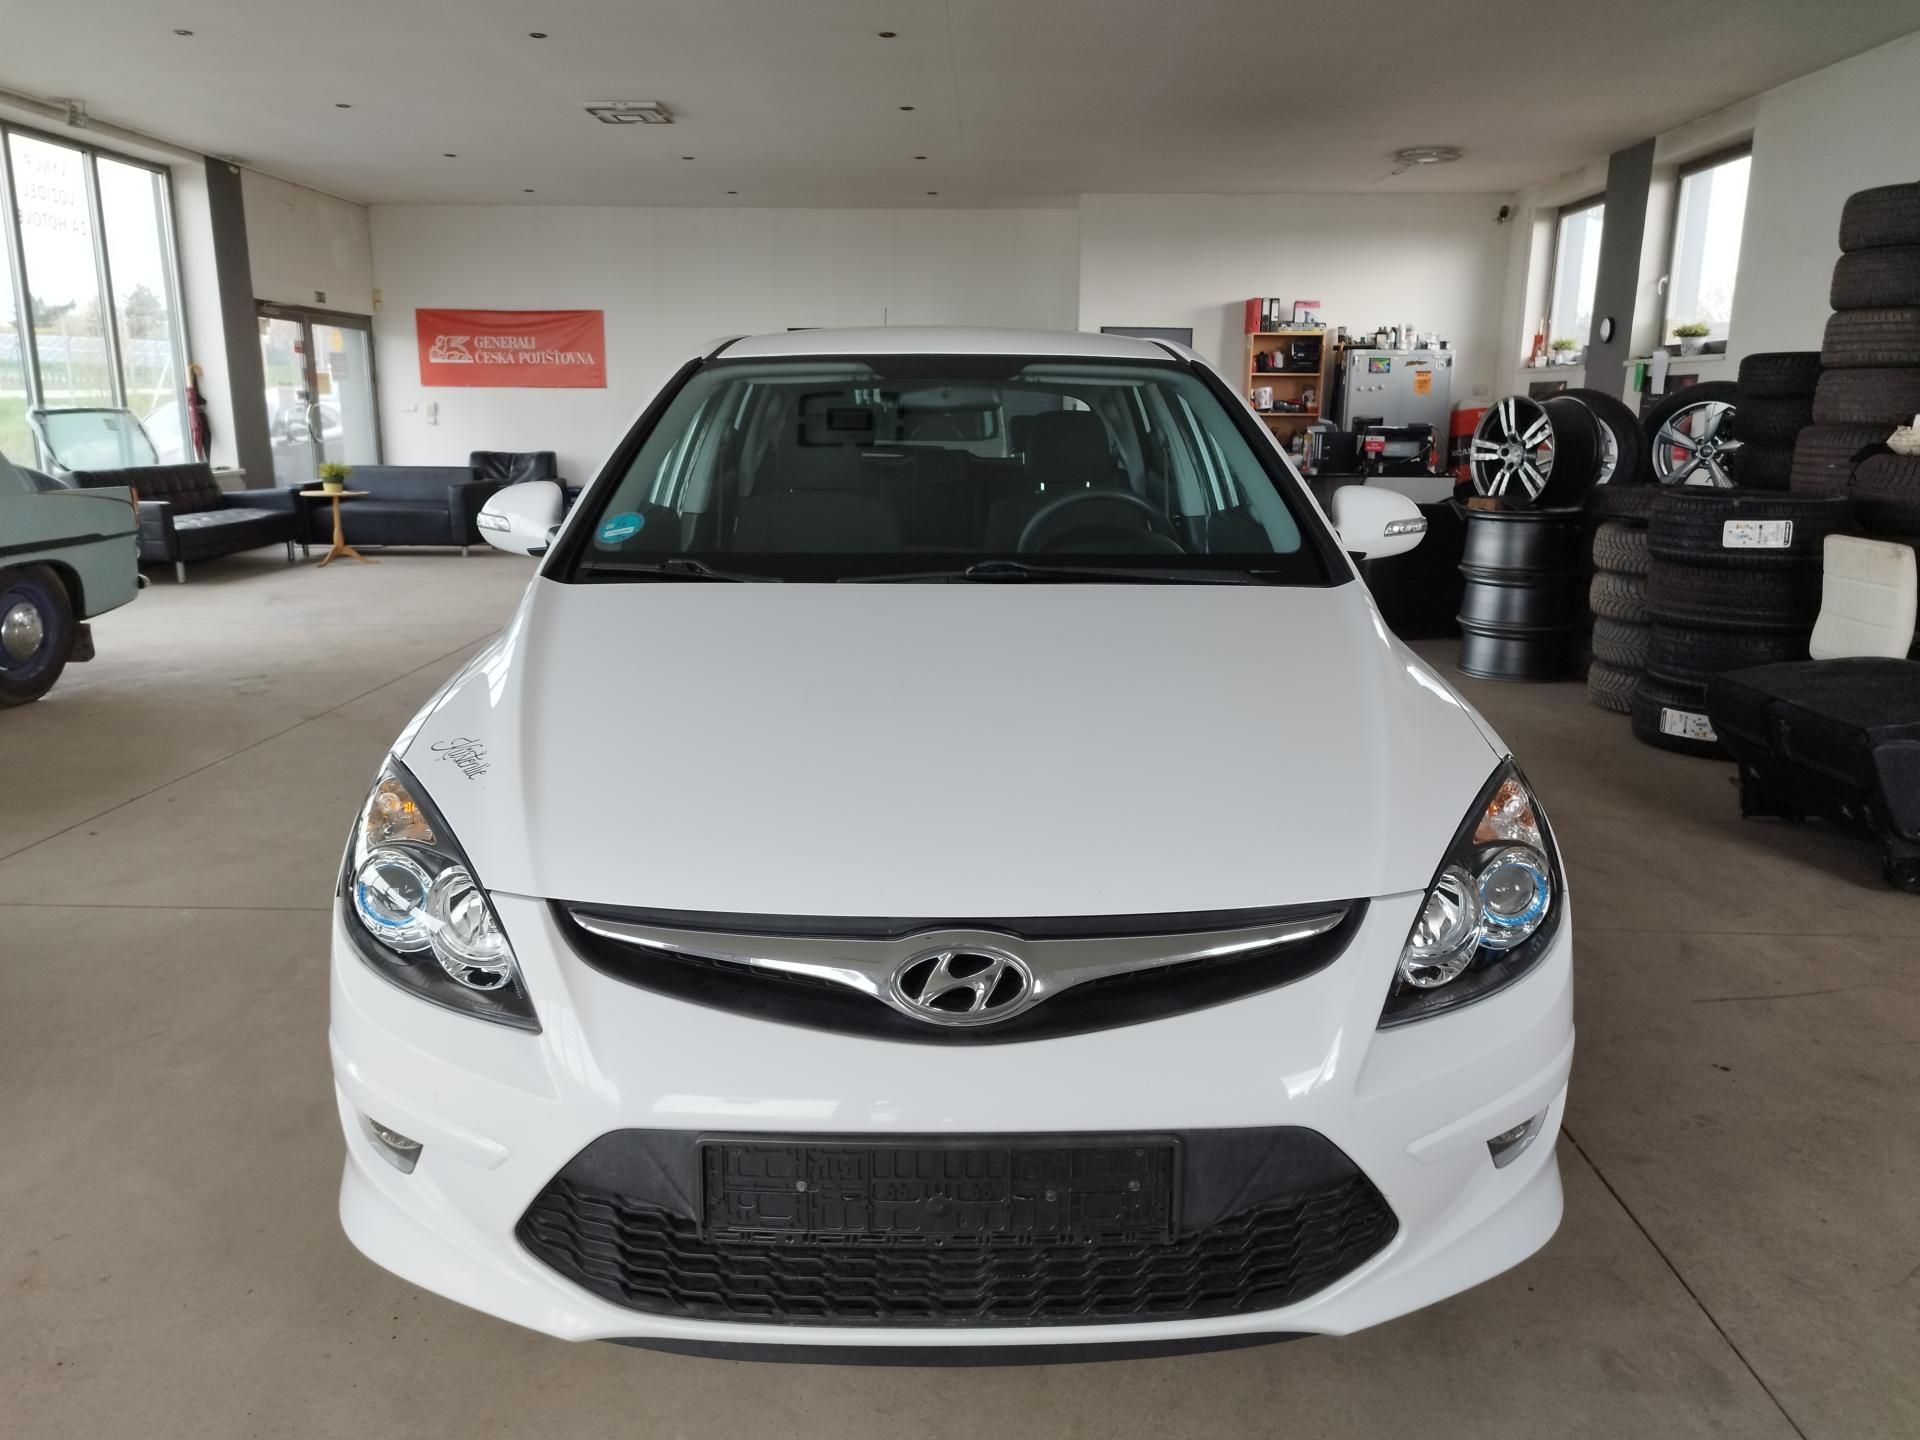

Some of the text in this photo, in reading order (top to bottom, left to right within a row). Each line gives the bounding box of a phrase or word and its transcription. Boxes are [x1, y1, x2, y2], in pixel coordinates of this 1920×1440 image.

[474, 335, 536, 350] GENERALI
[475, 349, 595, 366] ČESKÁ POJIŠŤOVNA
